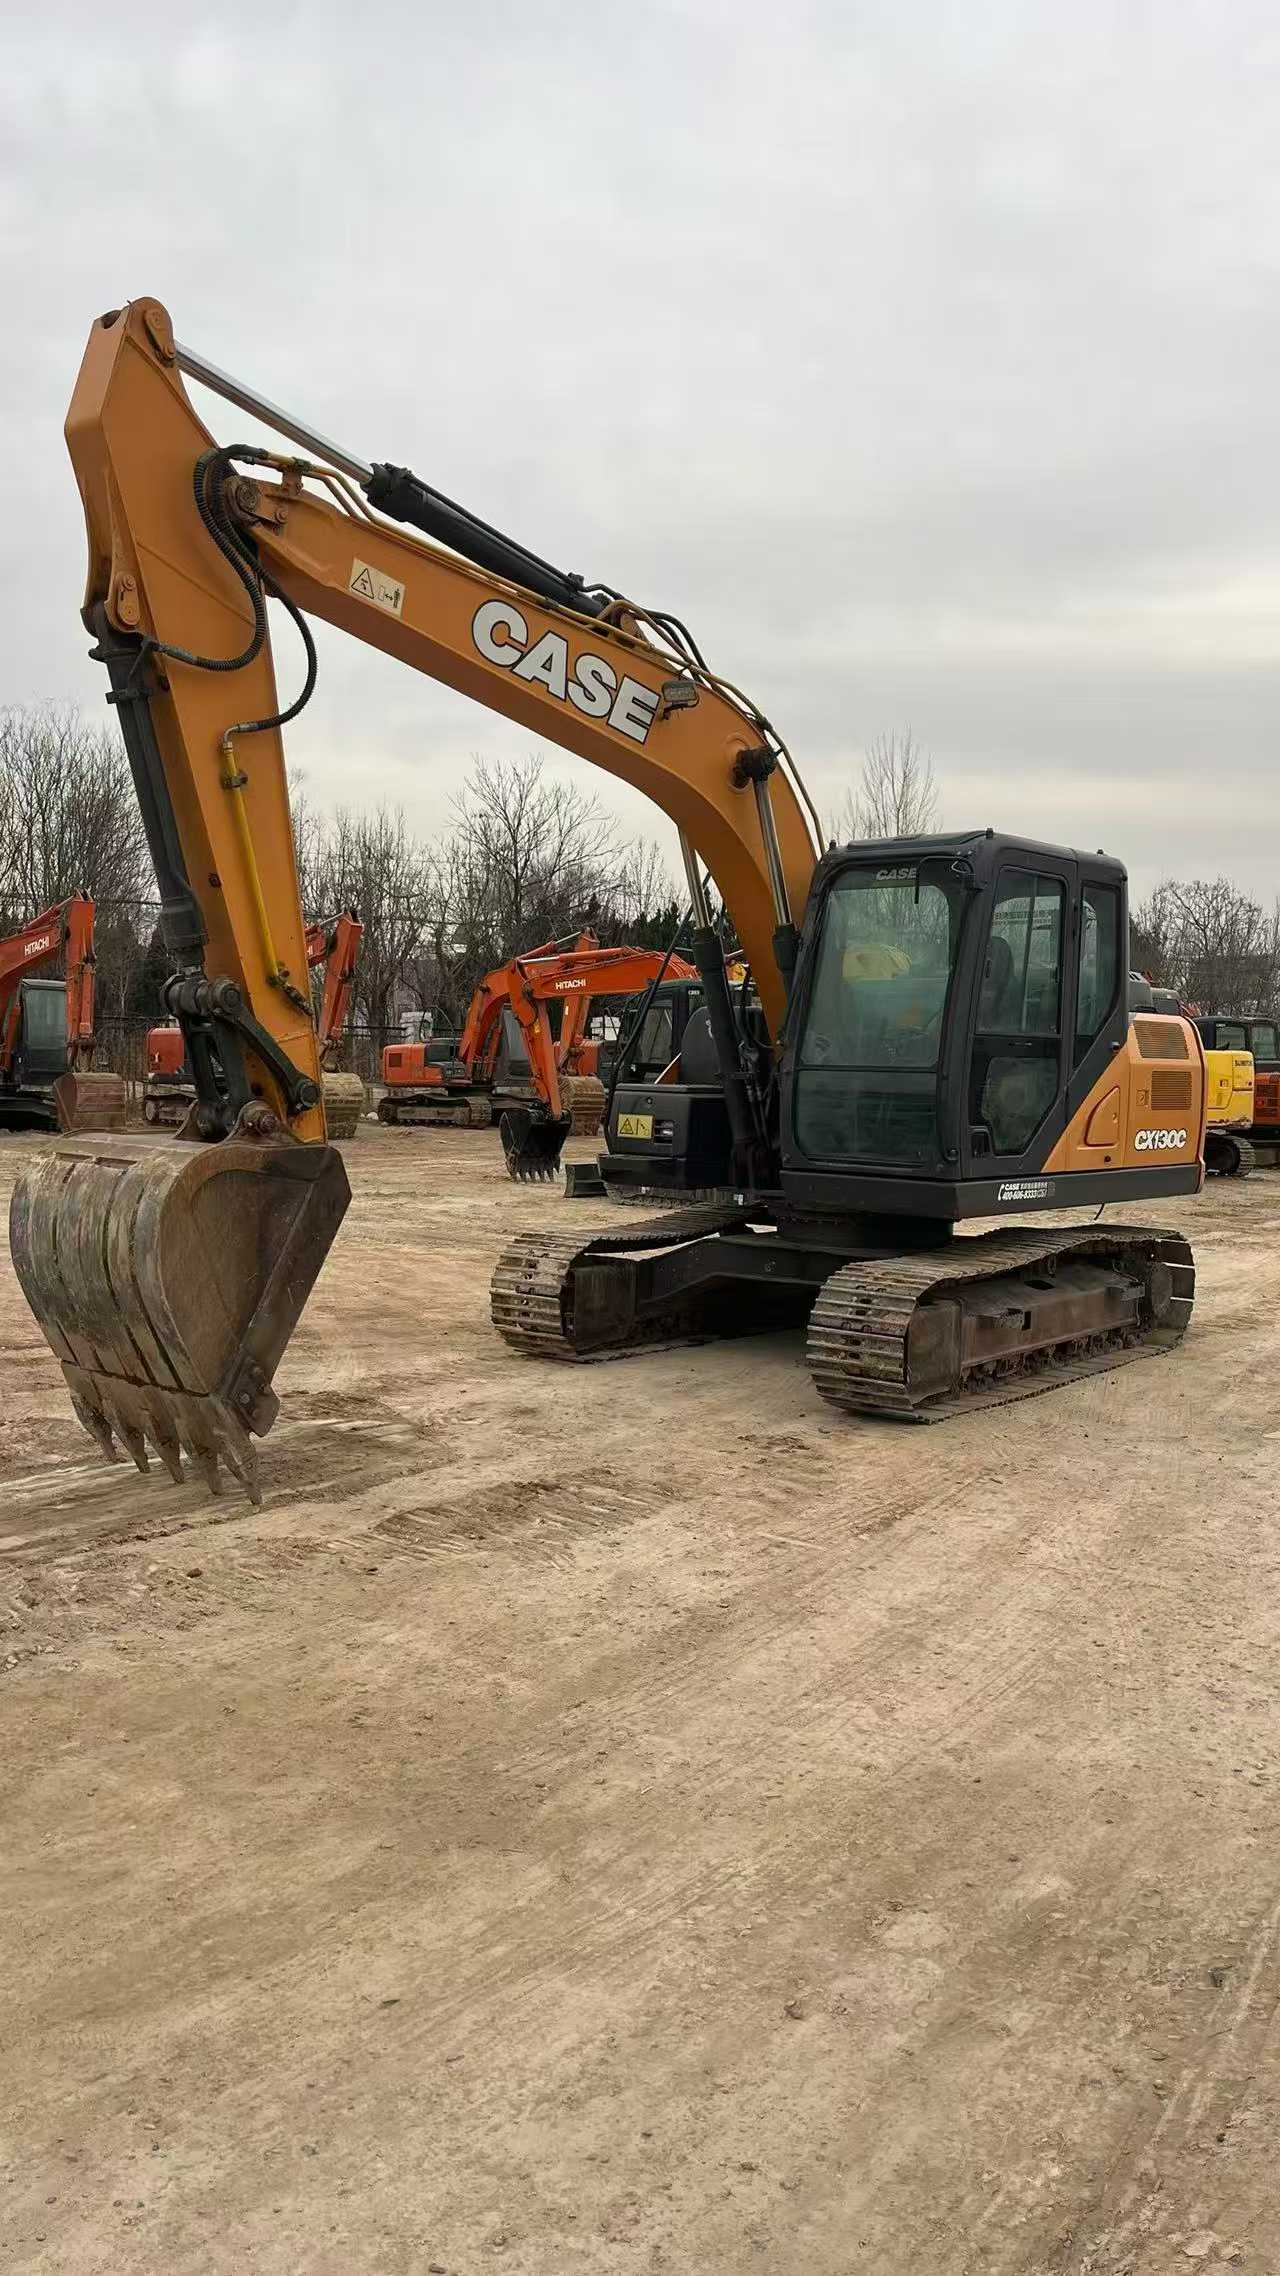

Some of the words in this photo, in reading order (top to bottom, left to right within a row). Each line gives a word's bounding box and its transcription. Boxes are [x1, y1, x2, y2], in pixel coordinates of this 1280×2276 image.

[472, 599, 662, 745] CASE
[876, 867, 917, 881] CASE
[24, 936, 50, 956] HITACHI
[555, 979, 587, 990] HITACHI
[1134, 1128, 1187, 1151] CX130C
